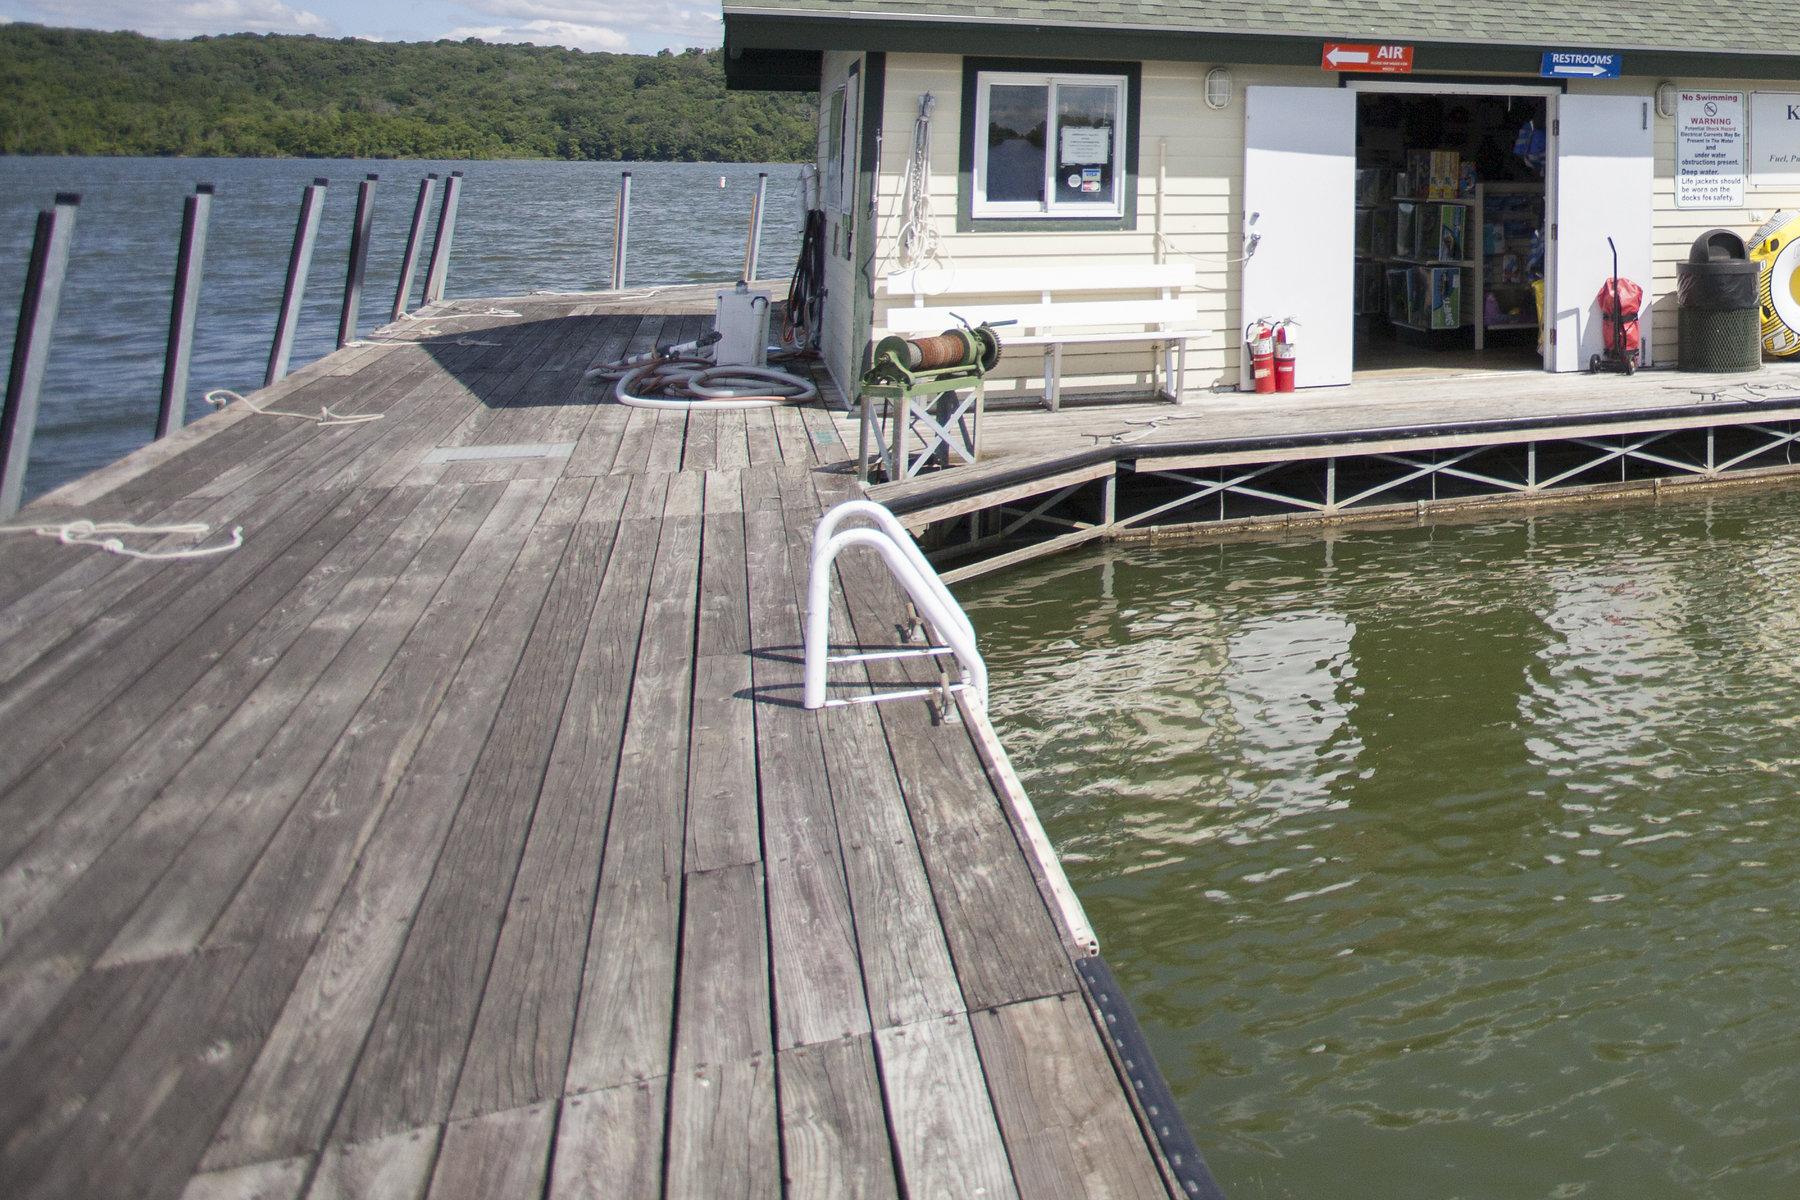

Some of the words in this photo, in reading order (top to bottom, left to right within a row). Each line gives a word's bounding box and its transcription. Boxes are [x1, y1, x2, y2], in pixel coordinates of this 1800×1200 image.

[1377, 46, 1403, 59] AIR
[1552, 53, 1612, 65] RESTROOMS
[1695, 94, 1738, 102] Swimming
[1769, 154, 1788, 163] Fuel,
[1681, 168, 1698, 176] Deep
[1695, 178, 1718, 186] jackets
